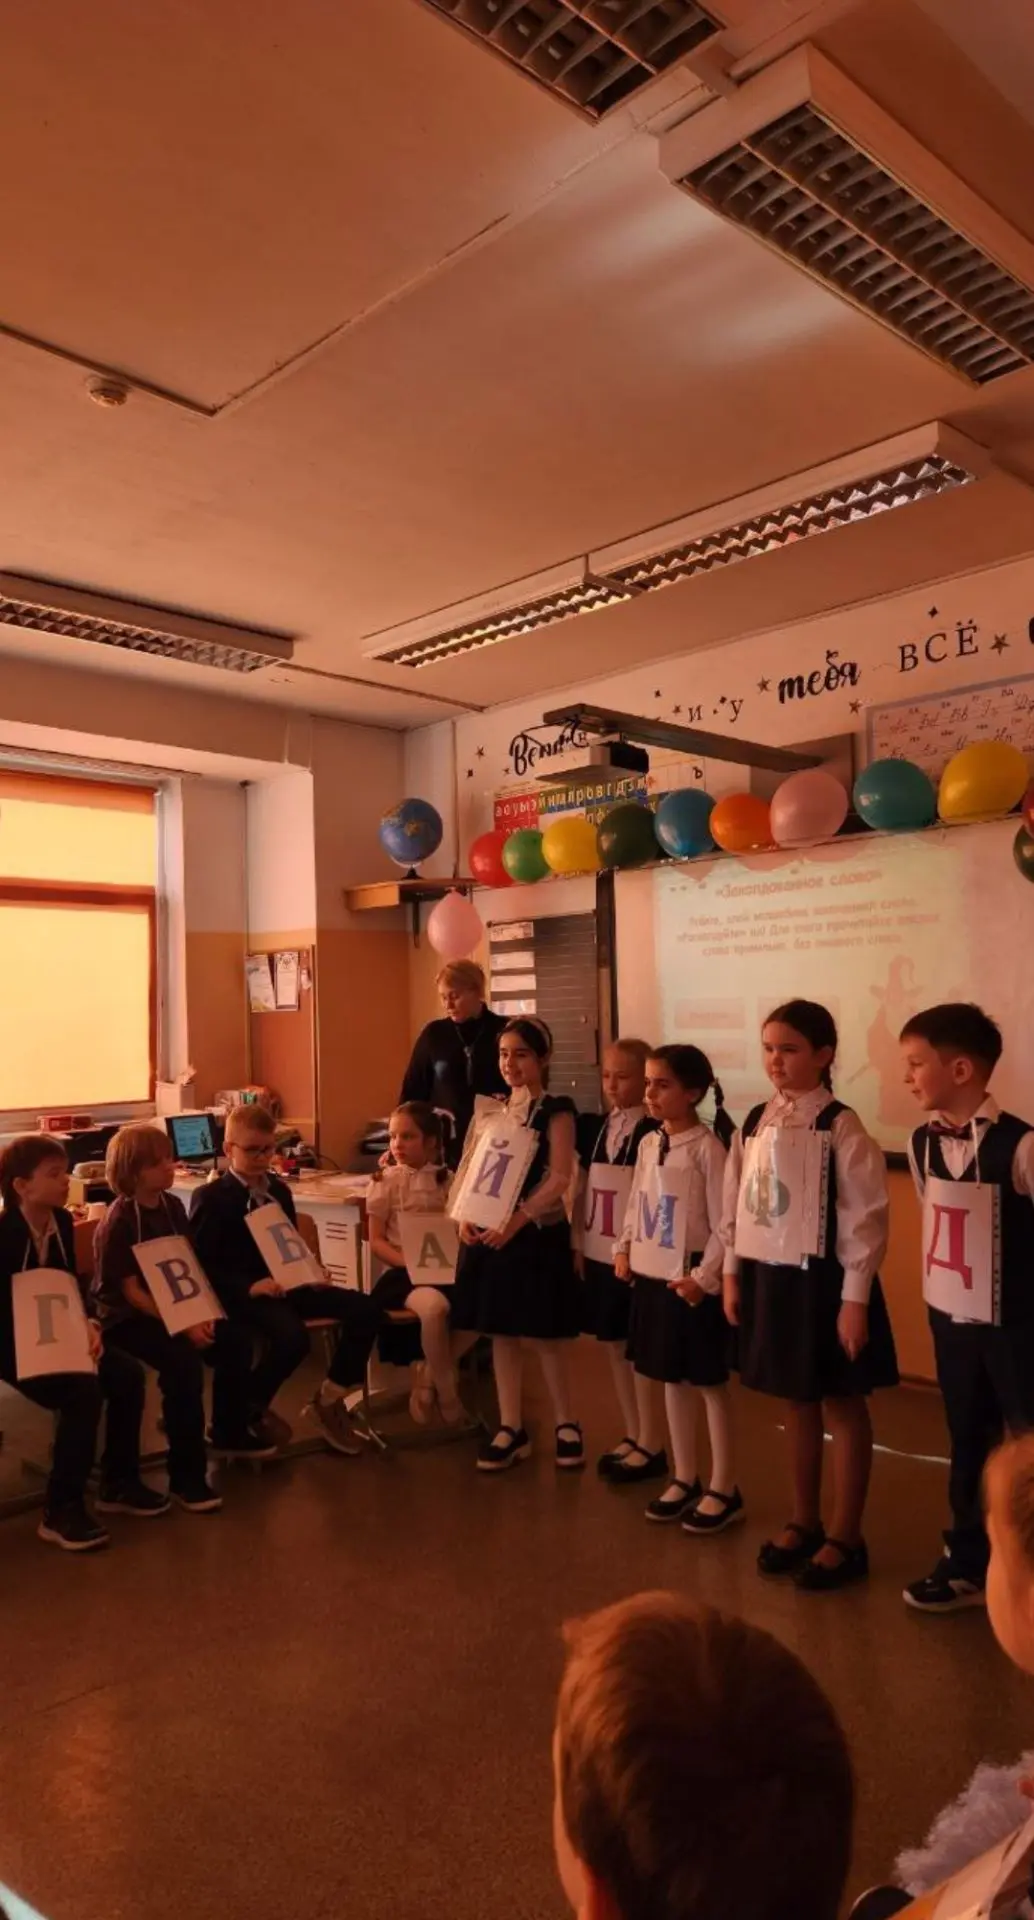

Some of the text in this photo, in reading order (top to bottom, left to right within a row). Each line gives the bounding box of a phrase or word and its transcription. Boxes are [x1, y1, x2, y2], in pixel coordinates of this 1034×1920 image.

[688, 704, 702, 723] и
[729, 699, 744, 723] у
[778, 649, 862, 704] тебя
[898, 619, 979, 673] ВСЁ
[471, 1139, 515, 1199] Й
[744, 1166, 791, 1227] Ф
[585, 1189, 619, 1239] Л
[636, 1190, 678, 1250] М
[266, 1222, 307, 1266] Б
[417, 1231, 454, 1269] А
[926, 1203, 973, 1290] Д
[155, 1258, 202, 1304] В
[34, 1293, 69, 1346] Г
